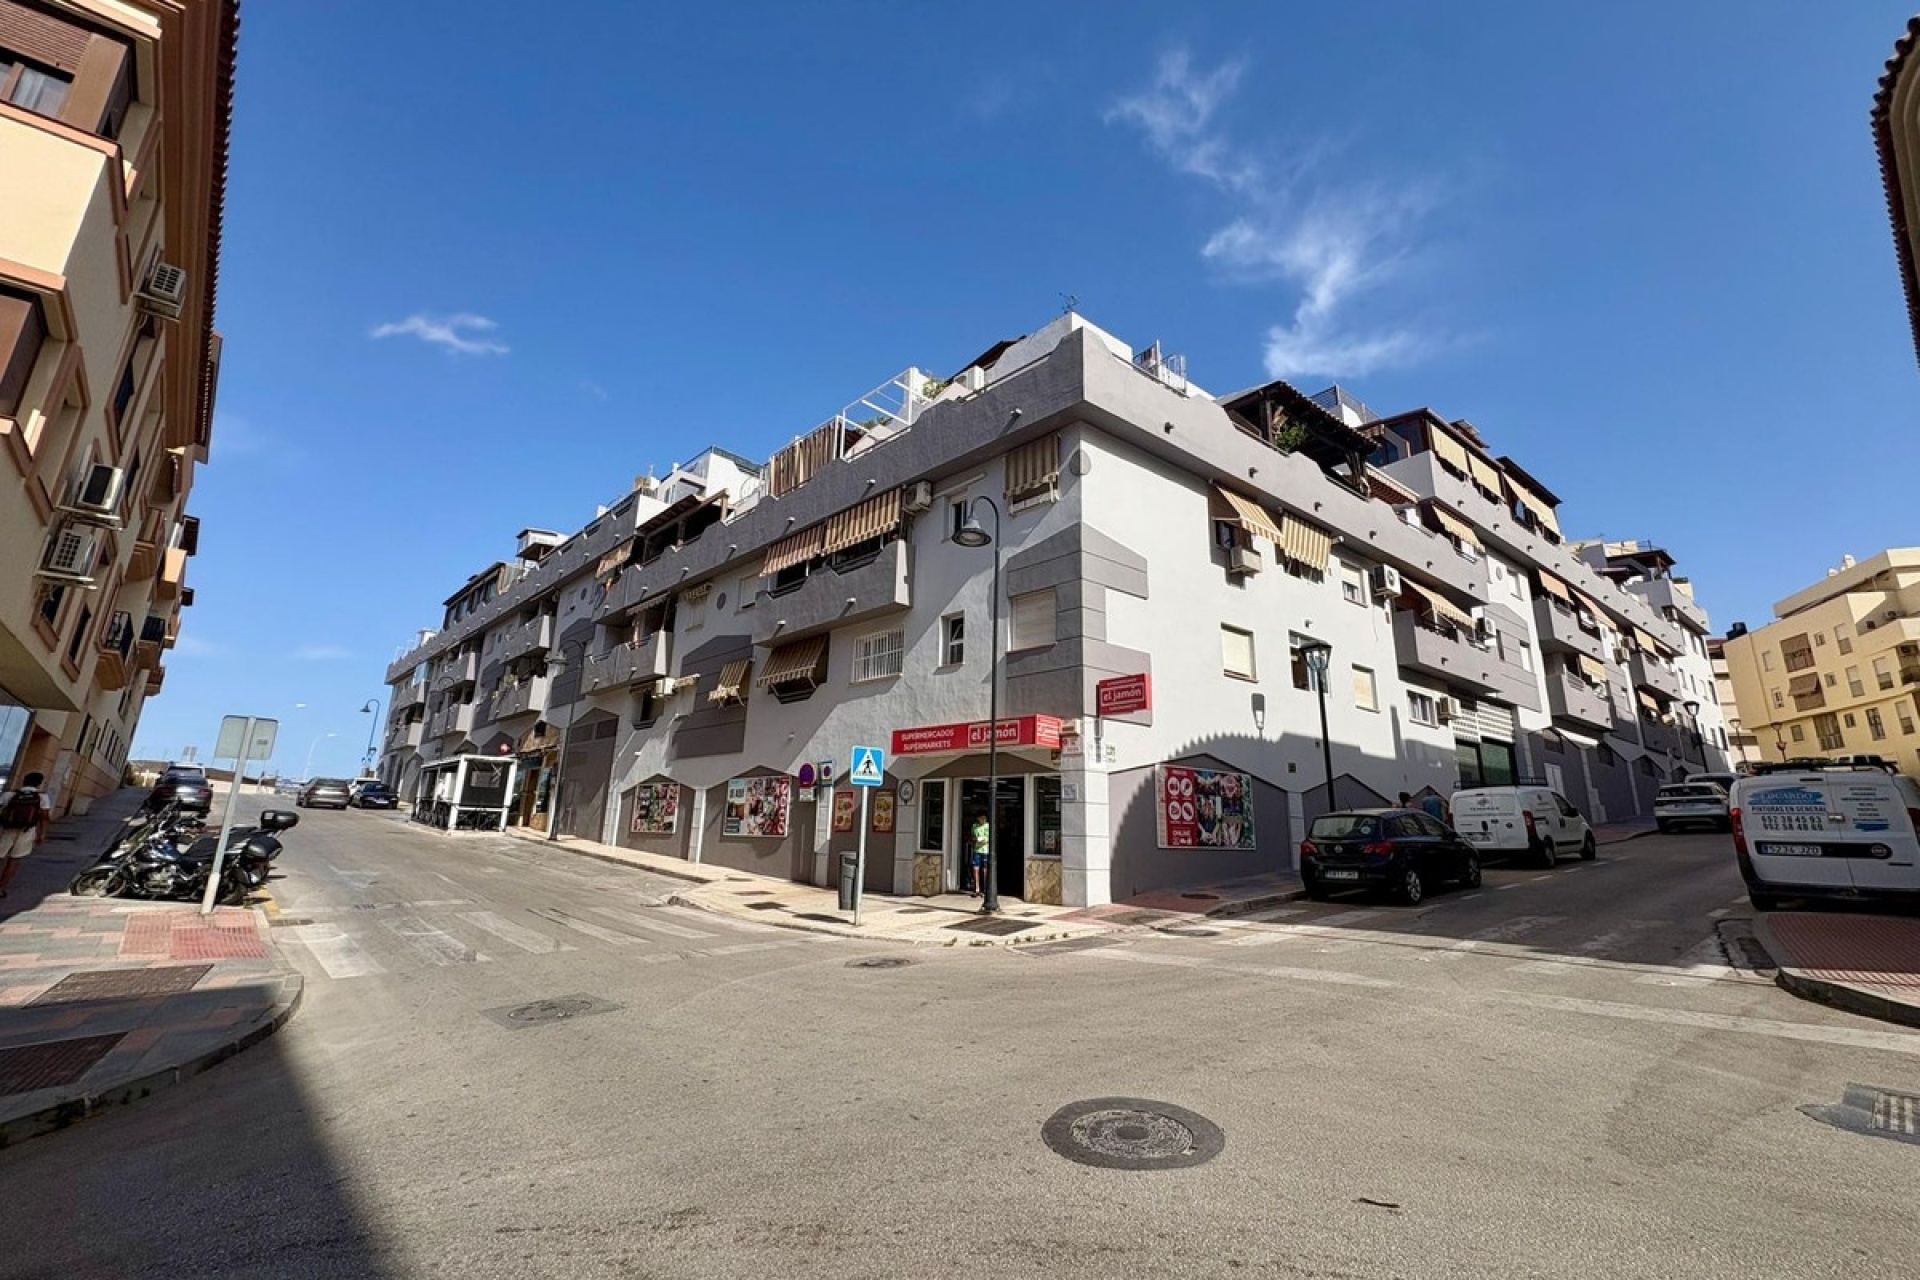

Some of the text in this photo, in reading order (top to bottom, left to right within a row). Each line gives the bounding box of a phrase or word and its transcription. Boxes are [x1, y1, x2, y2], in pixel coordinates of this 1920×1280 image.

[1103, 686, 1142, 702] el jamón
[901, 728, 955, 741] SUPERMERCADOS
[971, 723, 1017, 742] el jamón
[903, 740, 951, 752] SUPERMARKETS
